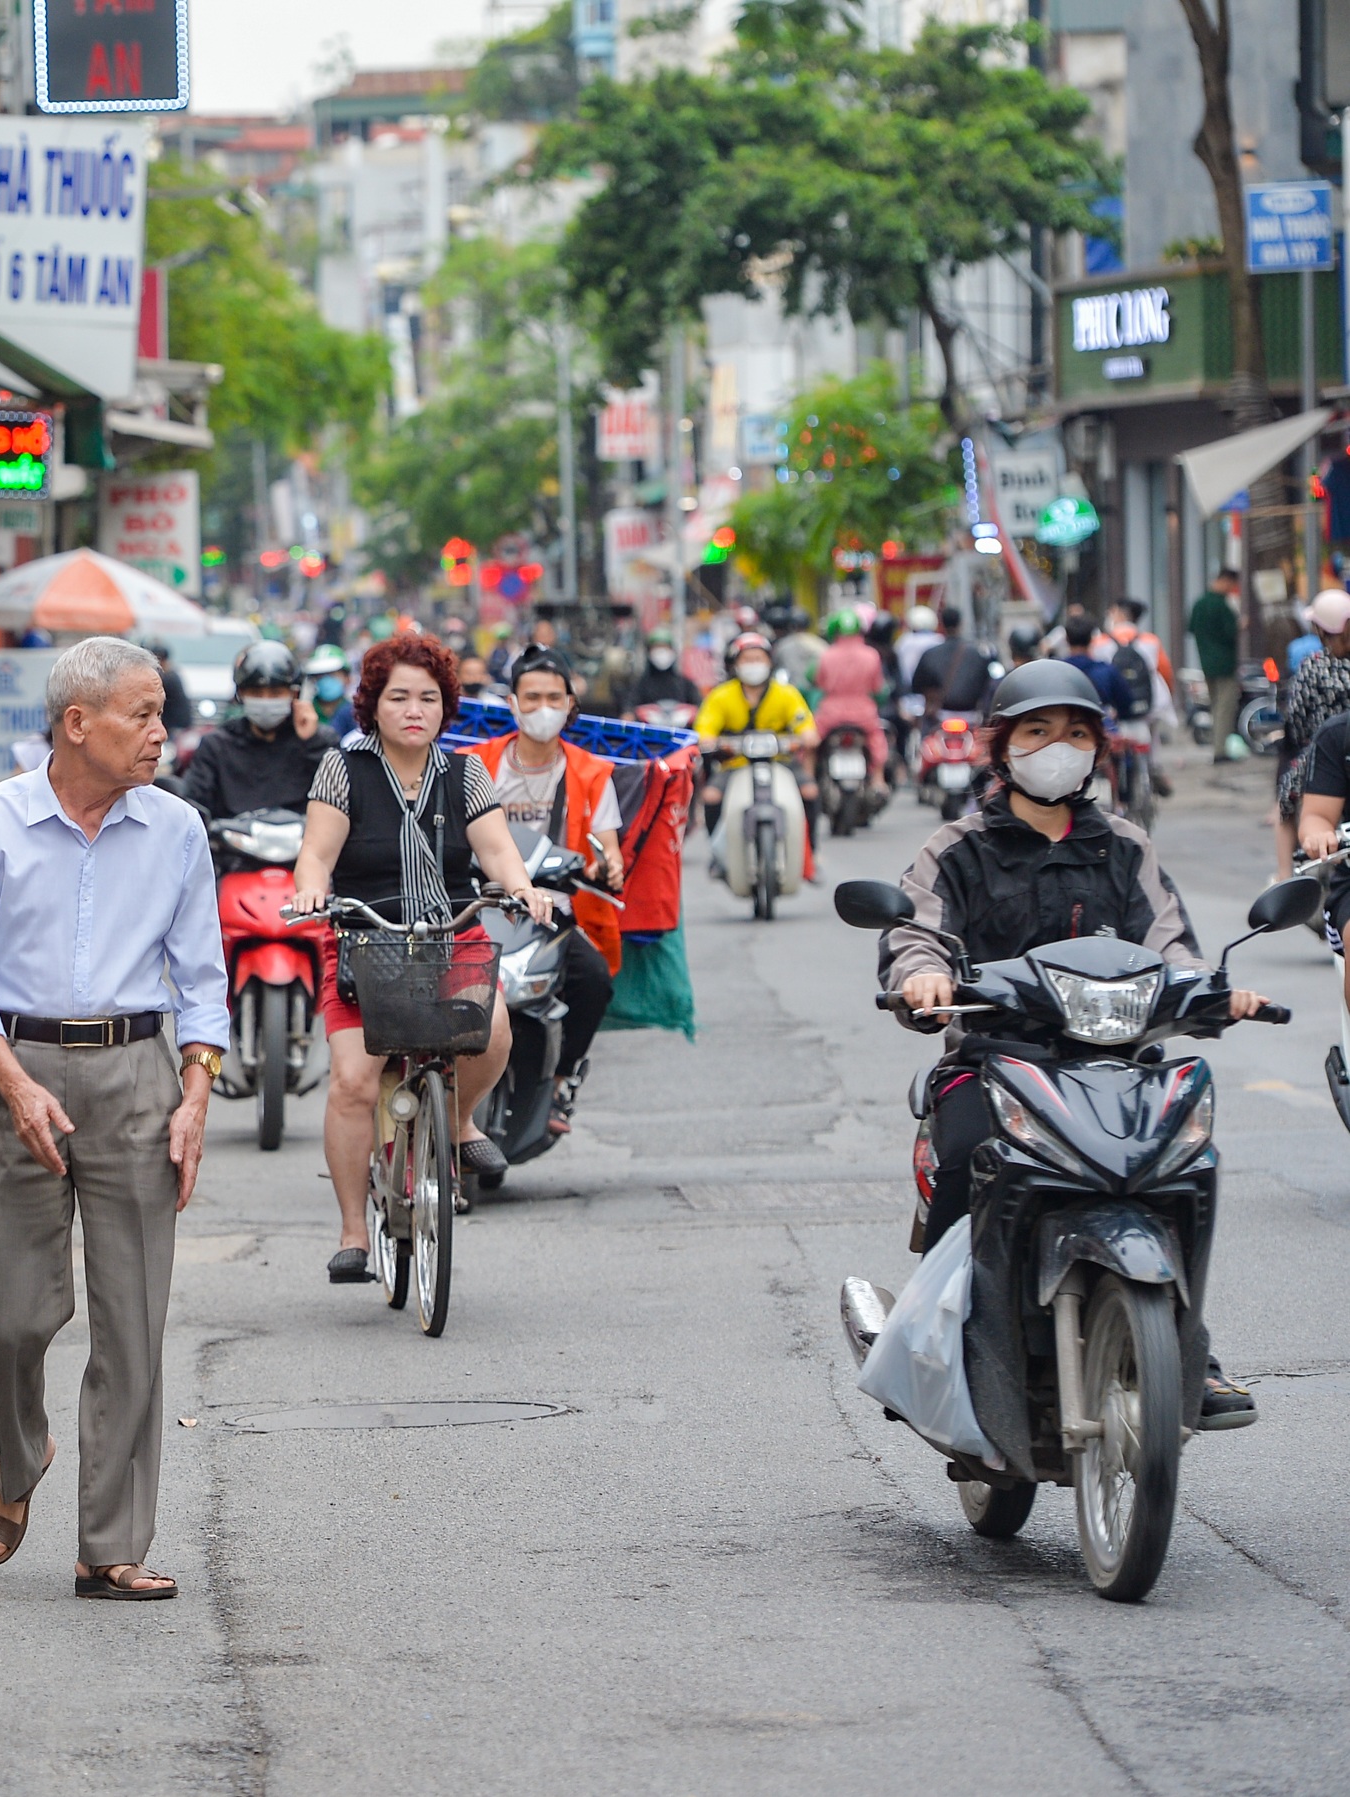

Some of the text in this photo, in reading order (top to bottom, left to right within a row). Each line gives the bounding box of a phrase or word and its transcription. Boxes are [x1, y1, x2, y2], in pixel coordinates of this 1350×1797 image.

[85, 41, 143, 98] AN
[44, 132, 136, 219] THUỐC
[9, 252, 23, 300] 6
[35, 245, 87, 304] TÂM
[96, 256, 133, 306] AN
